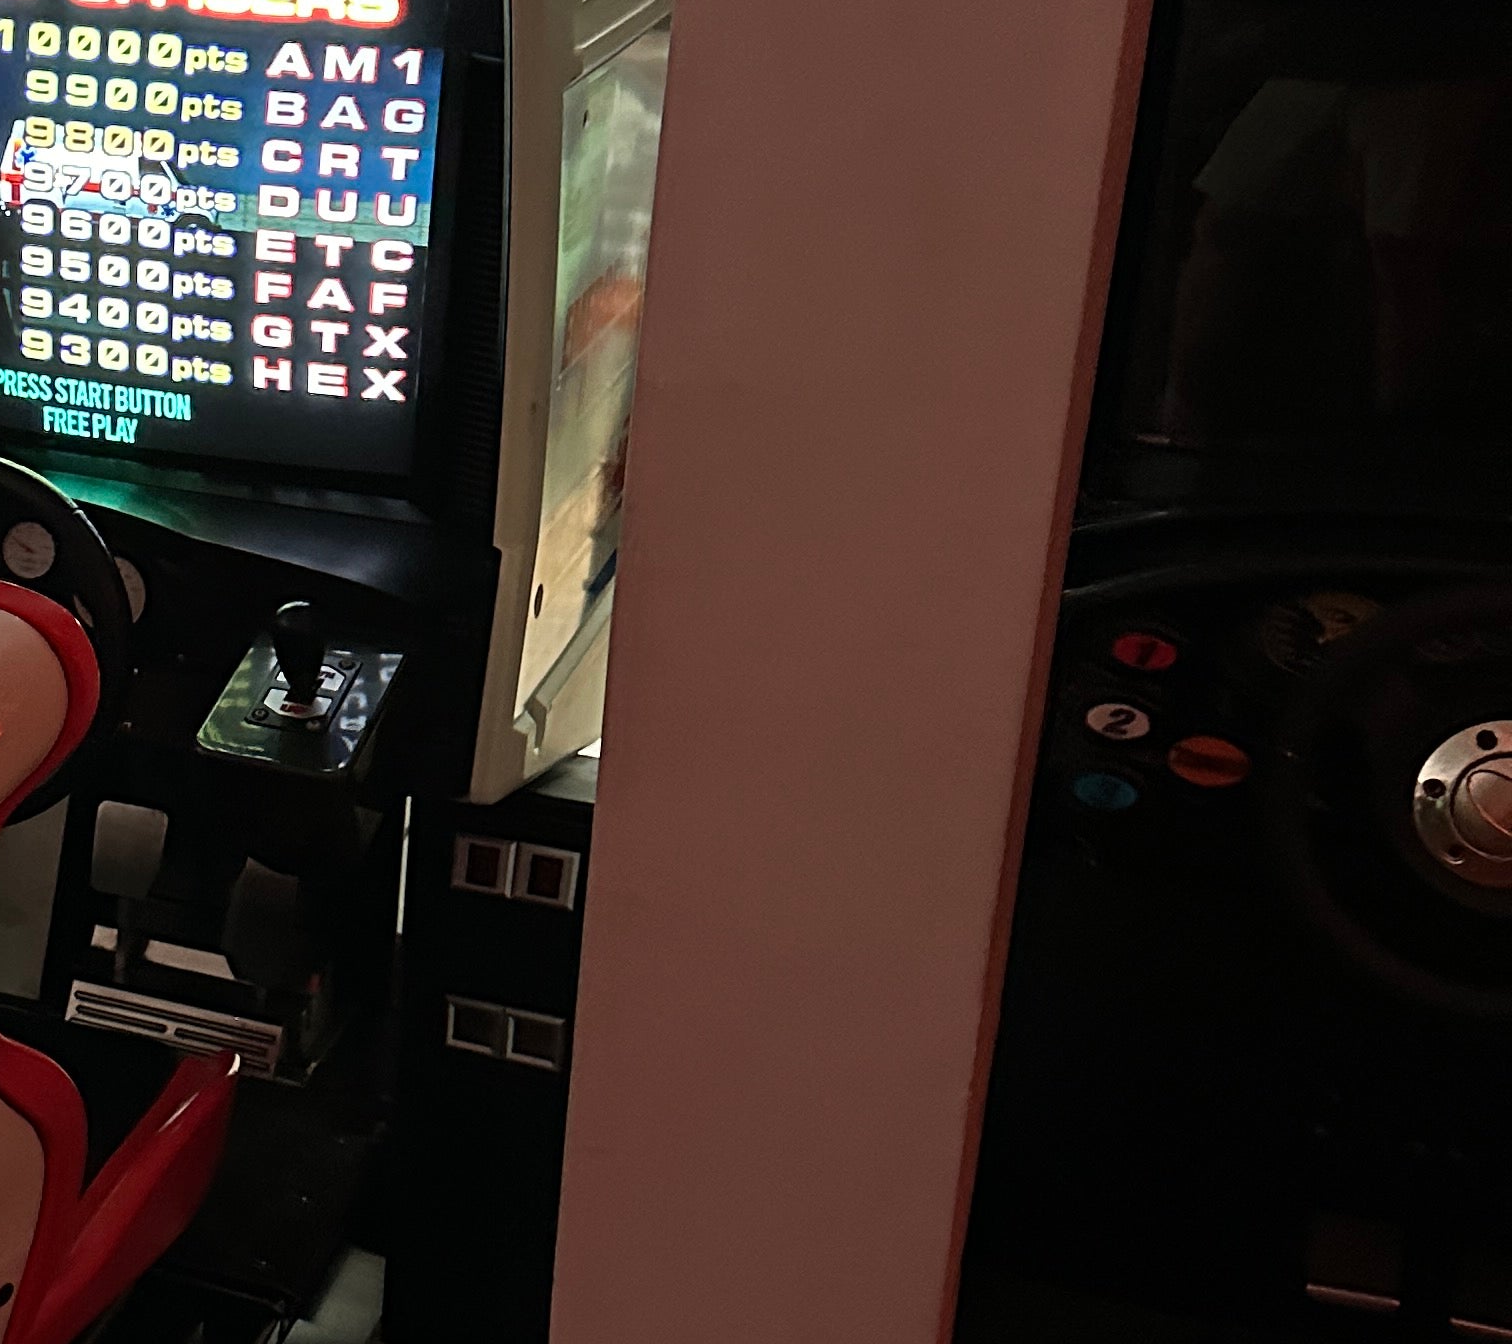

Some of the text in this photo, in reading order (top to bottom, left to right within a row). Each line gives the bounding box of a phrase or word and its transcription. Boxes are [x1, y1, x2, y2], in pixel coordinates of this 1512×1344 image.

[54, 377, 113, 410] START
[114, 384, 191, 420] BUTTON
[43, 406, 138, 444] FREE PLAY
[1102, 708, 1137, 735] 2
